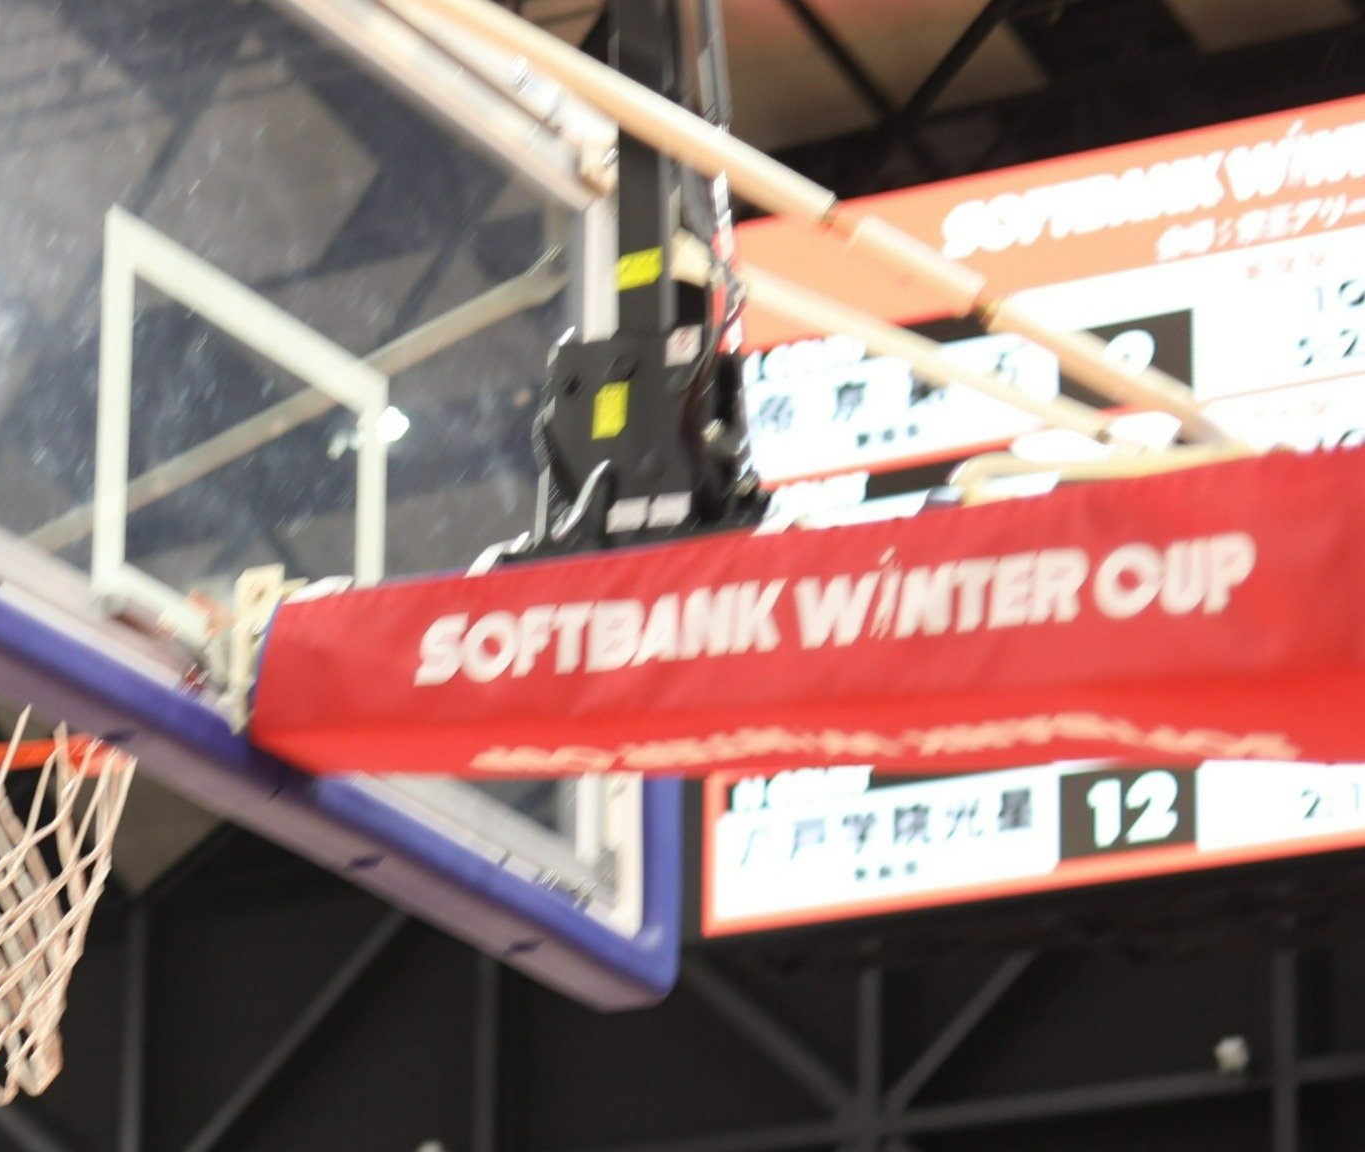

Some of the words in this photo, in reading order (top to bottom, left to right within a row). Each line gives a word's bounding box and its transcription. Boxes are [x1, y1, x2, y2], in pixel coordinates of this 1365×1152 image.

[413, 576, 788, 687] SOFTBANK
[794, 547, 1089, 648] WINTER
[1092, 530, 1258, 619] CUP
[1086, 769, 1179, 849] 12
